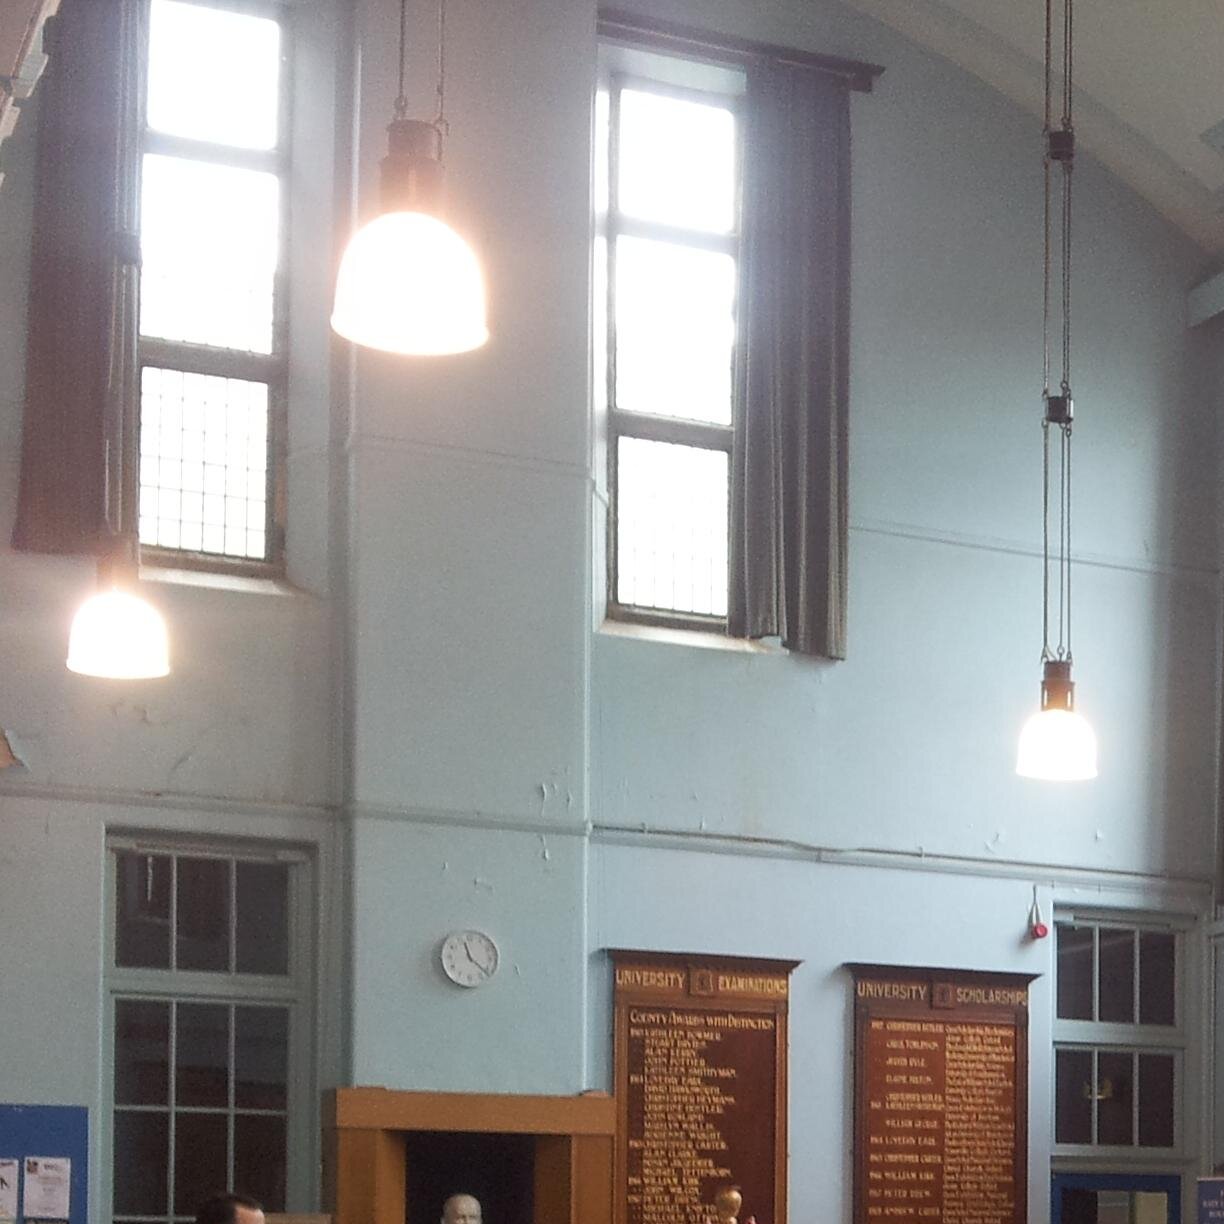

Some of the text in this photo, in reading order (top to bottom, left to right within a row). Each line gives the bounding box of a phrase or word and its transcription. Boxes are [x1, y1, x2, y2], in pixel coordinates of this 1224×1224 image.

[616, 969, 787, 994] UNIVERSITY EXAMINATIONS
[857, 983, 1027, 1006] UNIVERSITY SCHOLARSHIPS
